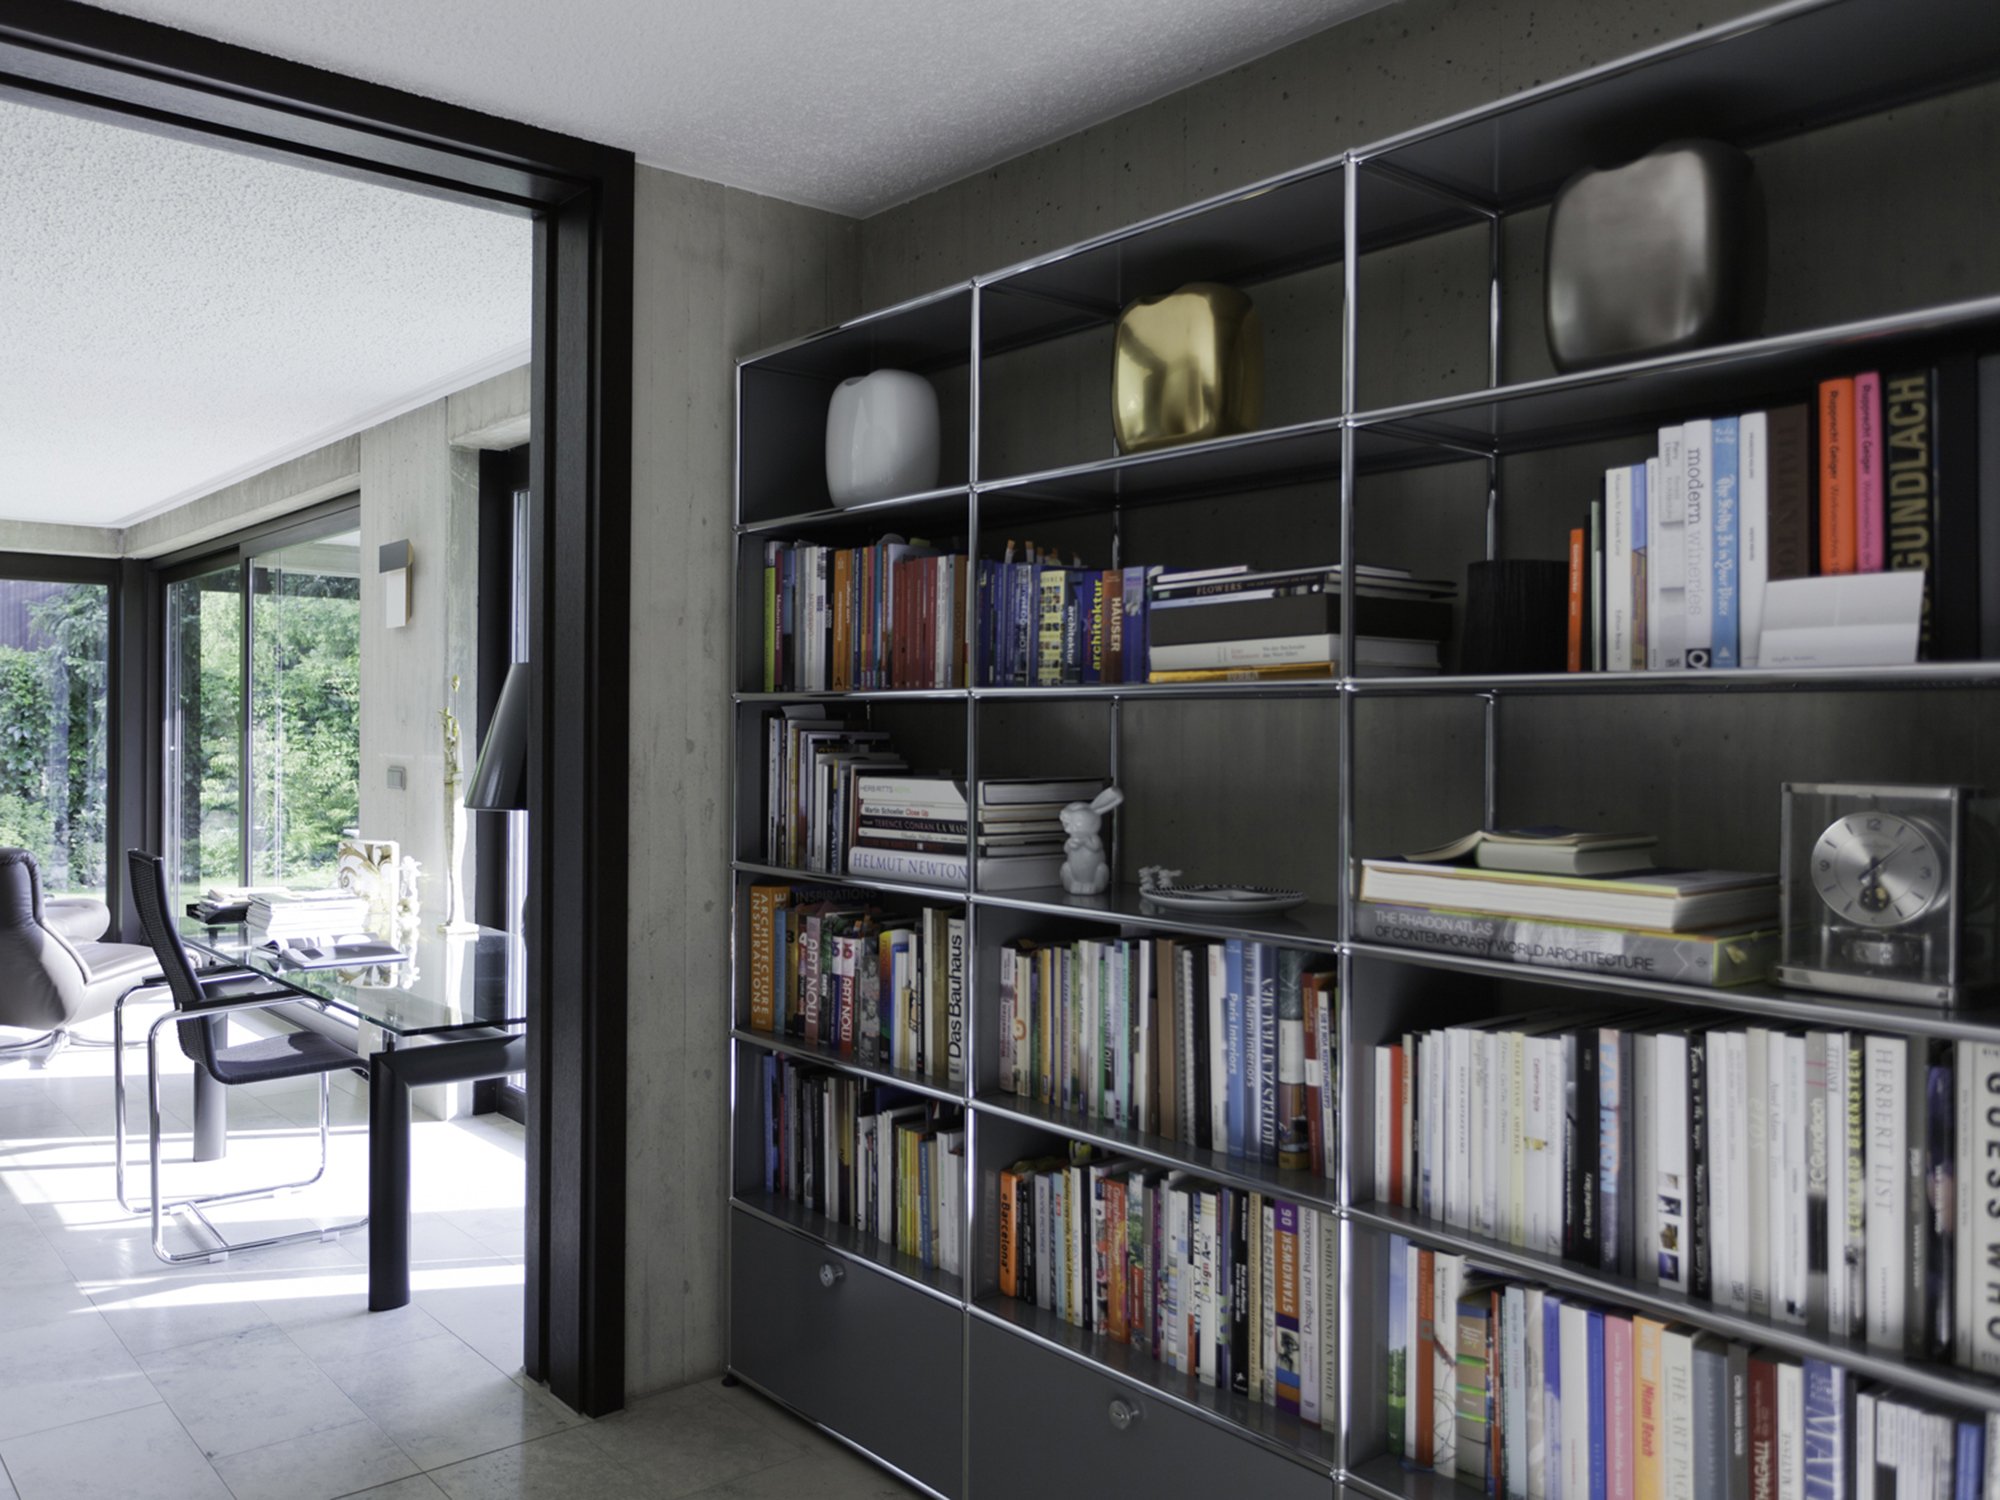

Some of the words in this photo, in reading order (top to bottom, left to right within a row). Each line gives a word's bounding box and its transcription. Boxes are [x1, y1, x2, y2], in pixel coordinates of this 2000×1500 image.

[1829, 390, 1840, 444] Rupprecht
[1861, 384, 1872, 439] Rupprecht
[1829, 445, 1839, 479] Geiger
[1861, 440, 1872, 475] Geiger
[1887, 375, 1931, 571] GUNDLACH
[1687, 447, 1705, 526] modern
[1688, 531, 1705, 617] wineries
[1067, 605, 1077, 665] architektur
[1091, 578, 1102, 672] architektur
[864, 806, 880, 814] Martin
[874, 818, 902, 829] TERENCE
[903, 820, 935, 832] CONRAN
[1866, 818, 1881, 831] 12
[853, 853, 904, 873] HELMUT
[908, 859, 968, 880] NEWTON
[1819, 859, 1830, 872] 9
[1920, 866, 1931, 880] 3
[1374, 910, 1397, 924] THE
[1398, 912, 1453, 931] PHAIDON
[1453, 918, 1494, 936] ATLAS
[752, 892, 761, 1014] INSPIRATIONS
[760, 894, 769, 1015] ARCHITECTURE
[806, 937, 818, 977] ART
[1374, 925, 1393, 938] OF
[1394, 926, 1494, 953] CONTEMPORARY
[1495, 937, 1544, 958] WORLD
[1545, 945, 1655, 972] ARCHITECTURE
[841, 976, 852, 1005] ART
[947, 934, 962, 1019] Bauhaus
[806, 977, 818, 1024] NOW
[1228, 992, 1238, 1021] Paris
[1246, 995, 1257, 1034] Miami
[840, 1006, 852, 1041] NOW
[947, 1020, 962, 1059] Das
[1103, 1008, 1112, 1045] INSIDE
[1103, 1049, 1112, 1073] OUT
[1228, 1024, 1238, 1075] Interiors
[1246, 1036, 1256, 1088] Interiors
[1262, 1052, 1275, 1085] ZUM
[1262, 1087, 1275, 1147] HOTELS
[1849, 1048, 1861, 1149] BERNSTEIN
[1874, 1048, 1894, 1154] HERBERT
[1599, 1043, 1618, 1195] FASHION
[1849, 1156, 1861, 1238] LEONARD
[1874, 1163, 1894, 1212] LIST
[1281, 1208, 1292, 1226] 06
[1112, 1229, 1121, 1265] Design
[1323, 1228, 1334, 1280] FASHION
[1200, 1262, 1212, 1303] Design
[1281, 1231, 1293, 1313] STANKOWSKI
[1303, 1278, 1312, 1296] und
[1303, 1300, 1313, 1336] Design
[1323, 1284, 1334, 1336] DRAWING
[1323, 1360, 1334, 1400] VOGUE
[1671, 1365, 1687, 1405] THE
[1671, 1416, 1687, 1452] ART
[1753, 1440, 1771, 1500] HAGALL
